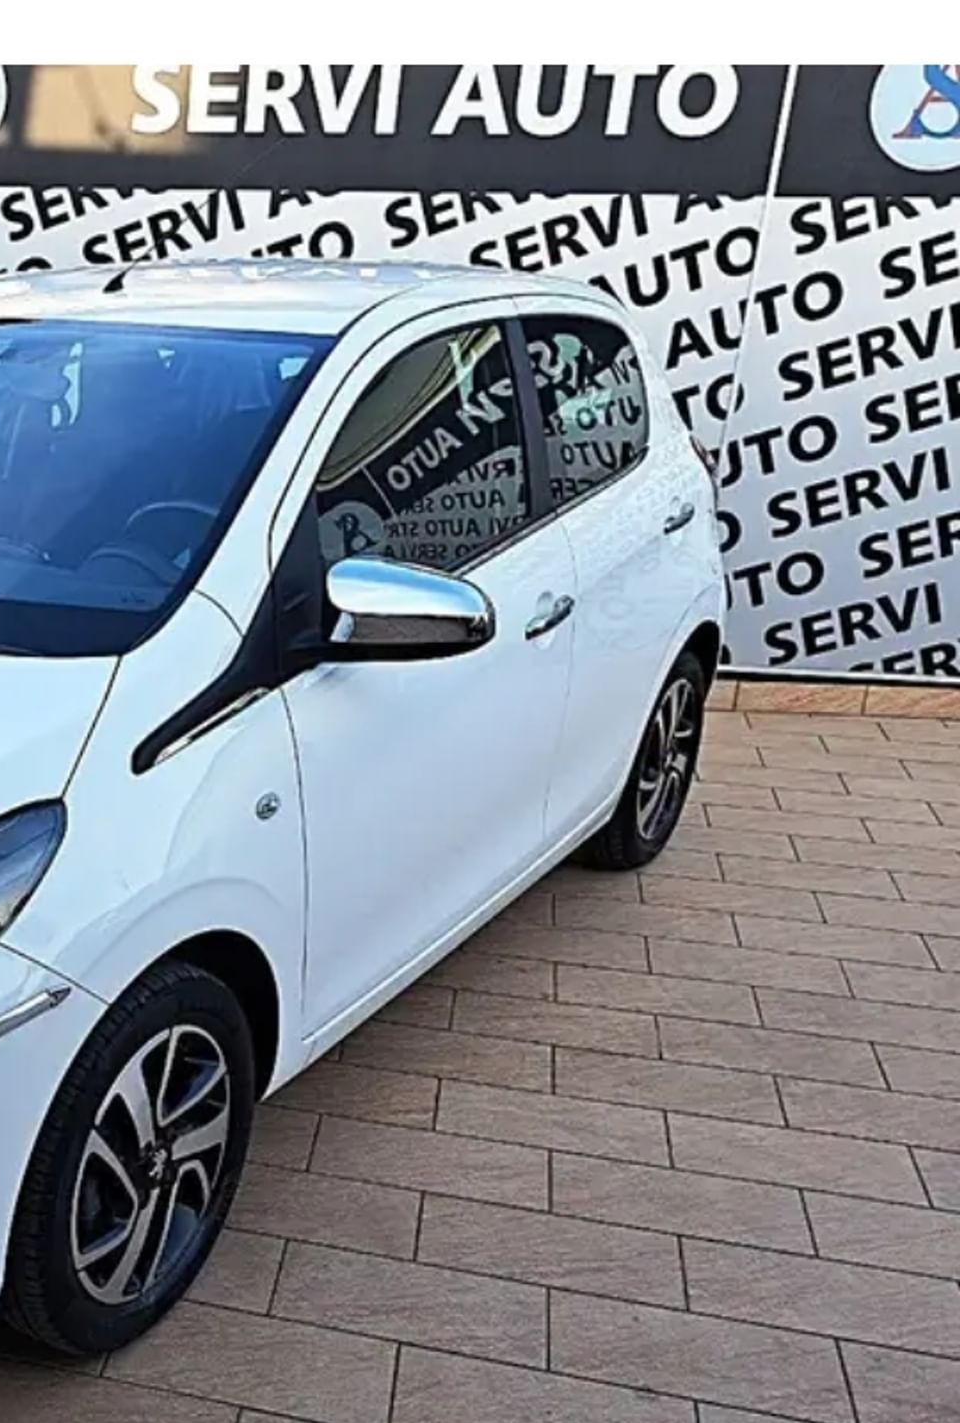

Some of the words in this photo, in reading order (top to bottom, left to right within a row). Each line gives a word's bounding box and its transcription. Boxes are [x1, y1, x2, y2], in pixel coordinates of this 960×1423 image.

[131, 65, 401, 135] SERVI
[431, 65, 740, 138] AUTO
[82, 192, 244, 264] SERVI
[666, 271, 843, 370] AUTO
[767, 447, 950, 538] SERVI
[764, 583, 941, 667] SERVI
